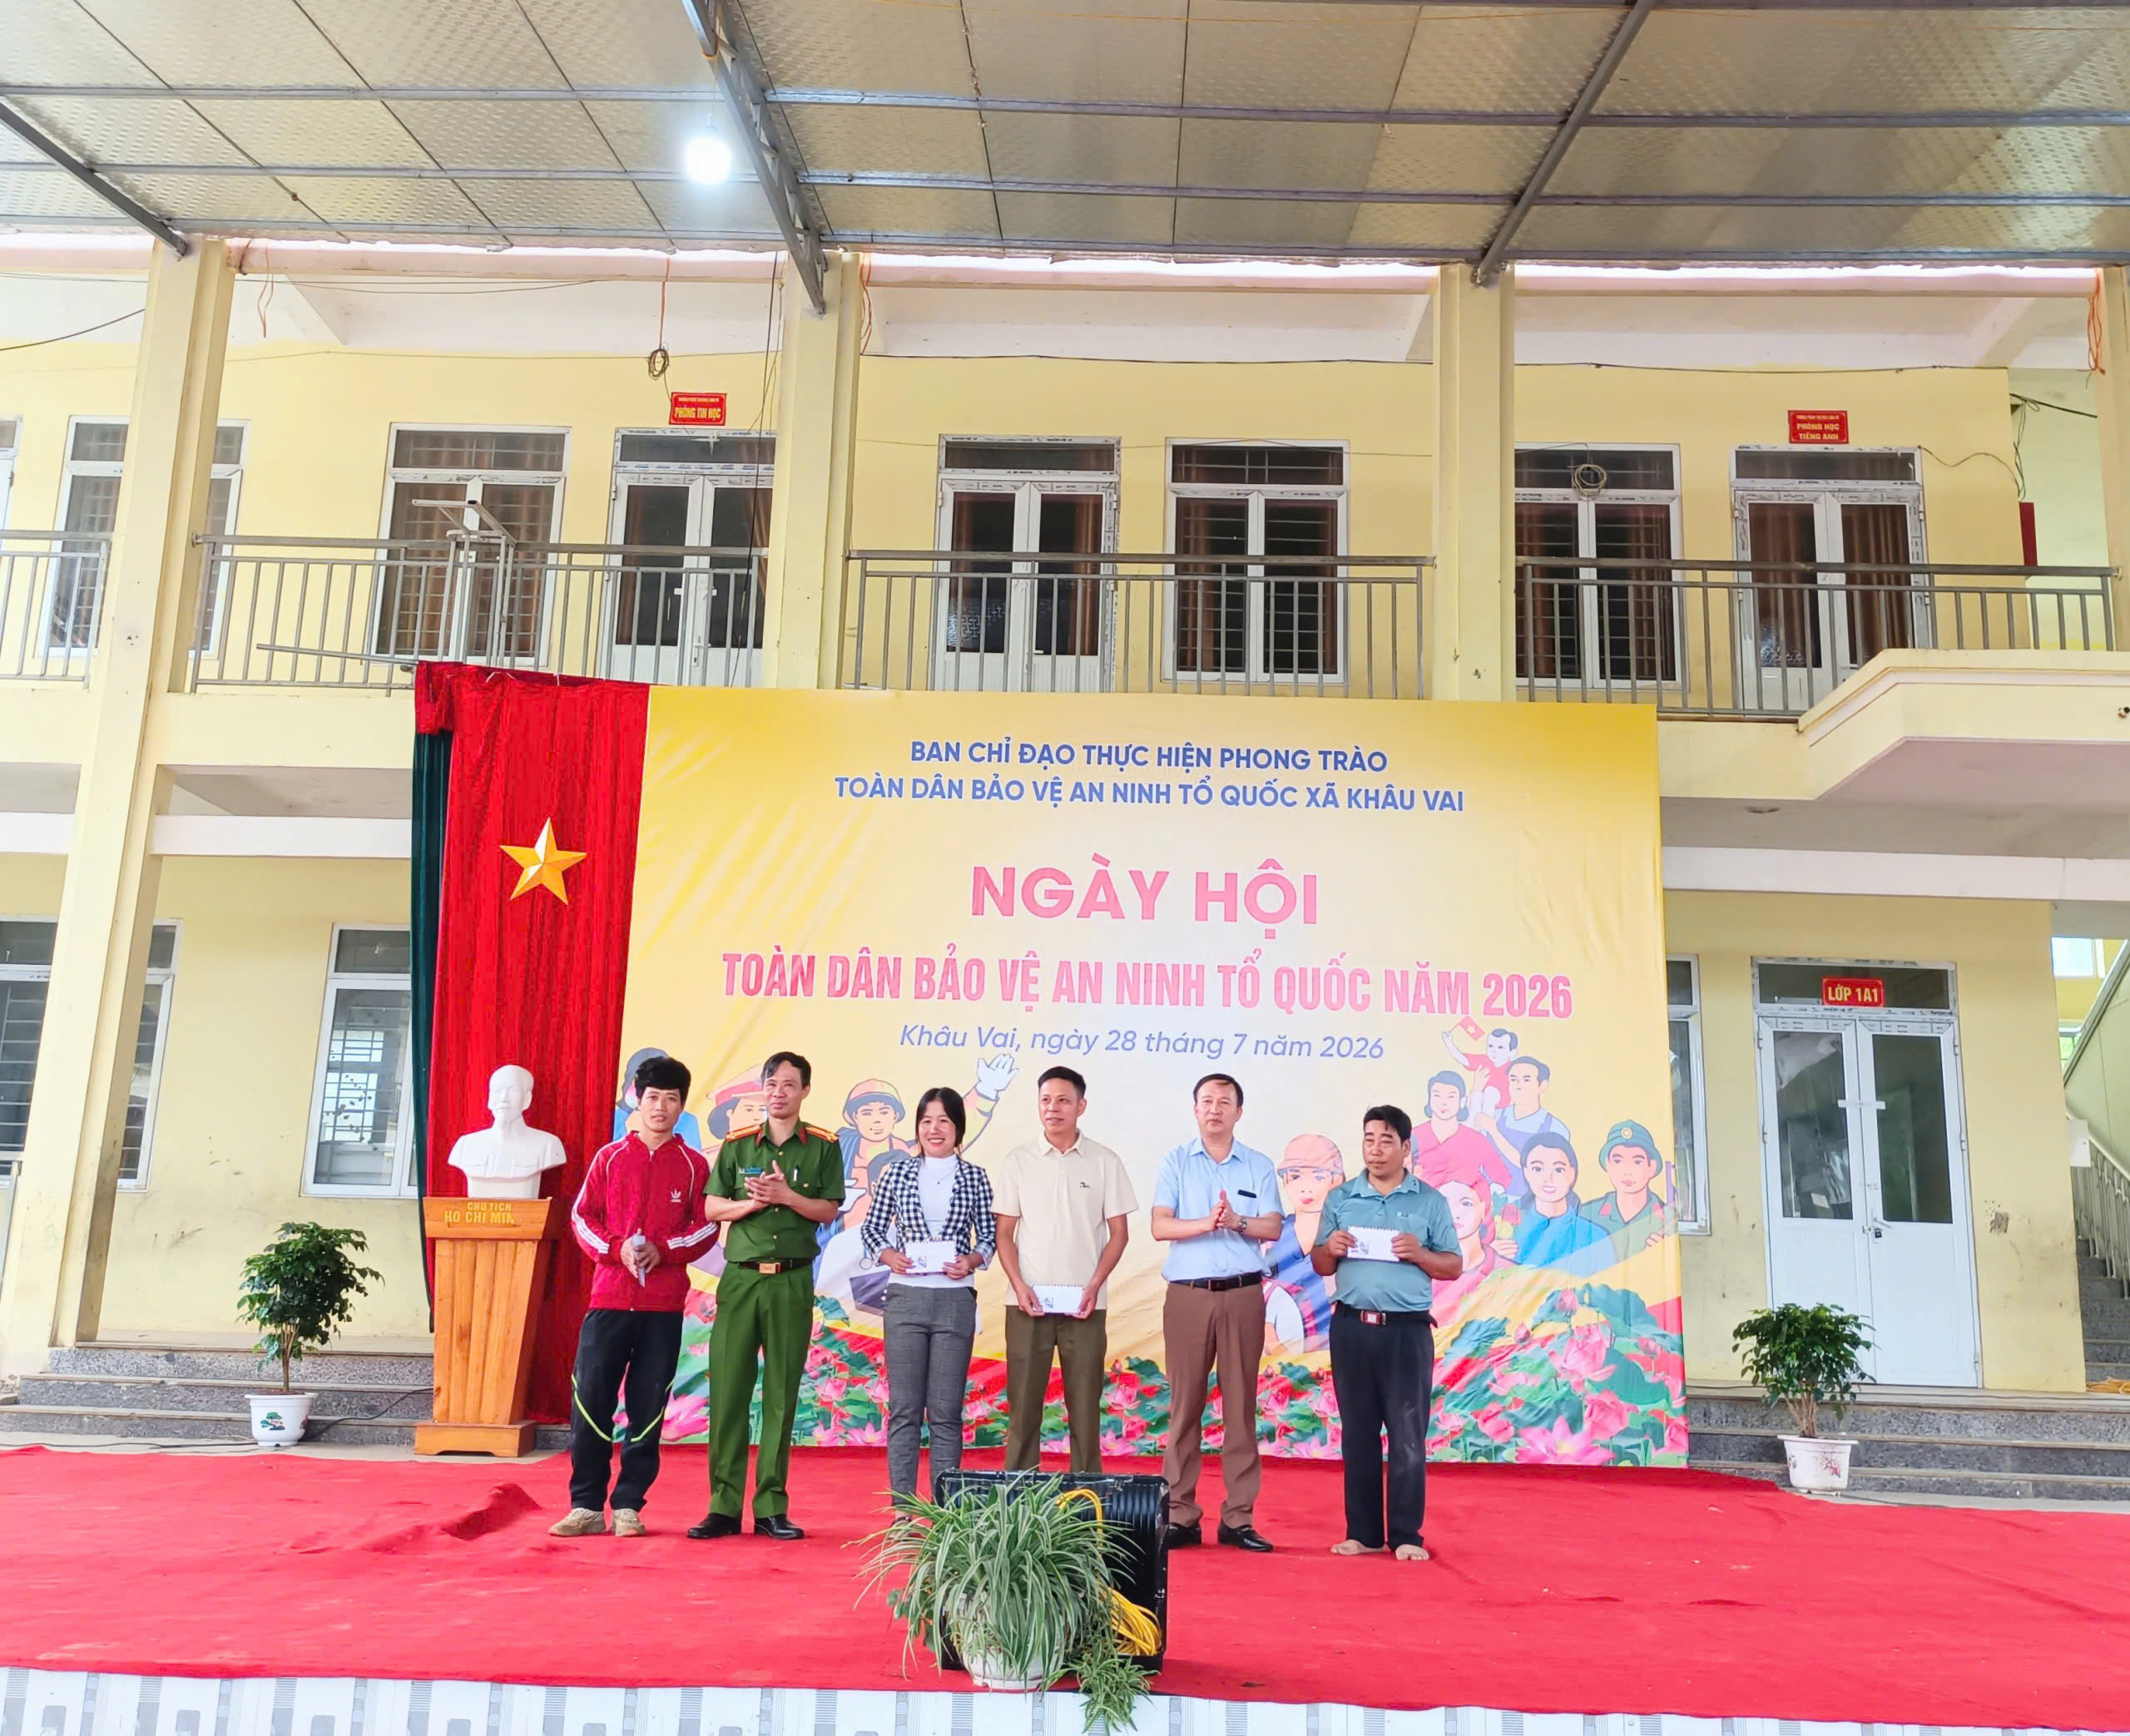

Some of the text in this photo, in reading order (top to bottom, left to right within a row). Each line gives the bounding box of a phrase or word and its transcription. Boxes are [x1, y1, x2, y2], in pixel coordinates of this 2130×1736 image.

[911, 736, 1388, 774] BAN CHỈ ĐẠO THỰC HIỆN PHONG TRÀO
[835, 772, 1464, 812] TOÀN DÂN BẢO VỆ AN NINH TỔ QUỐC XÃ KHÂU VAI
[971, 852, 1317, 939] NGÀY HỘI
[722, 942, 1573, 1019] TOÀN DÂN BẢO VỆ AN NINH TỔ QUỐC NĂM 2026
[1828, 983, 1878, 1002] LỚP 1A1
[899, 1024, 1384, 1060] Khâu Vai, ngày 28 tháng 7 năm 2026
